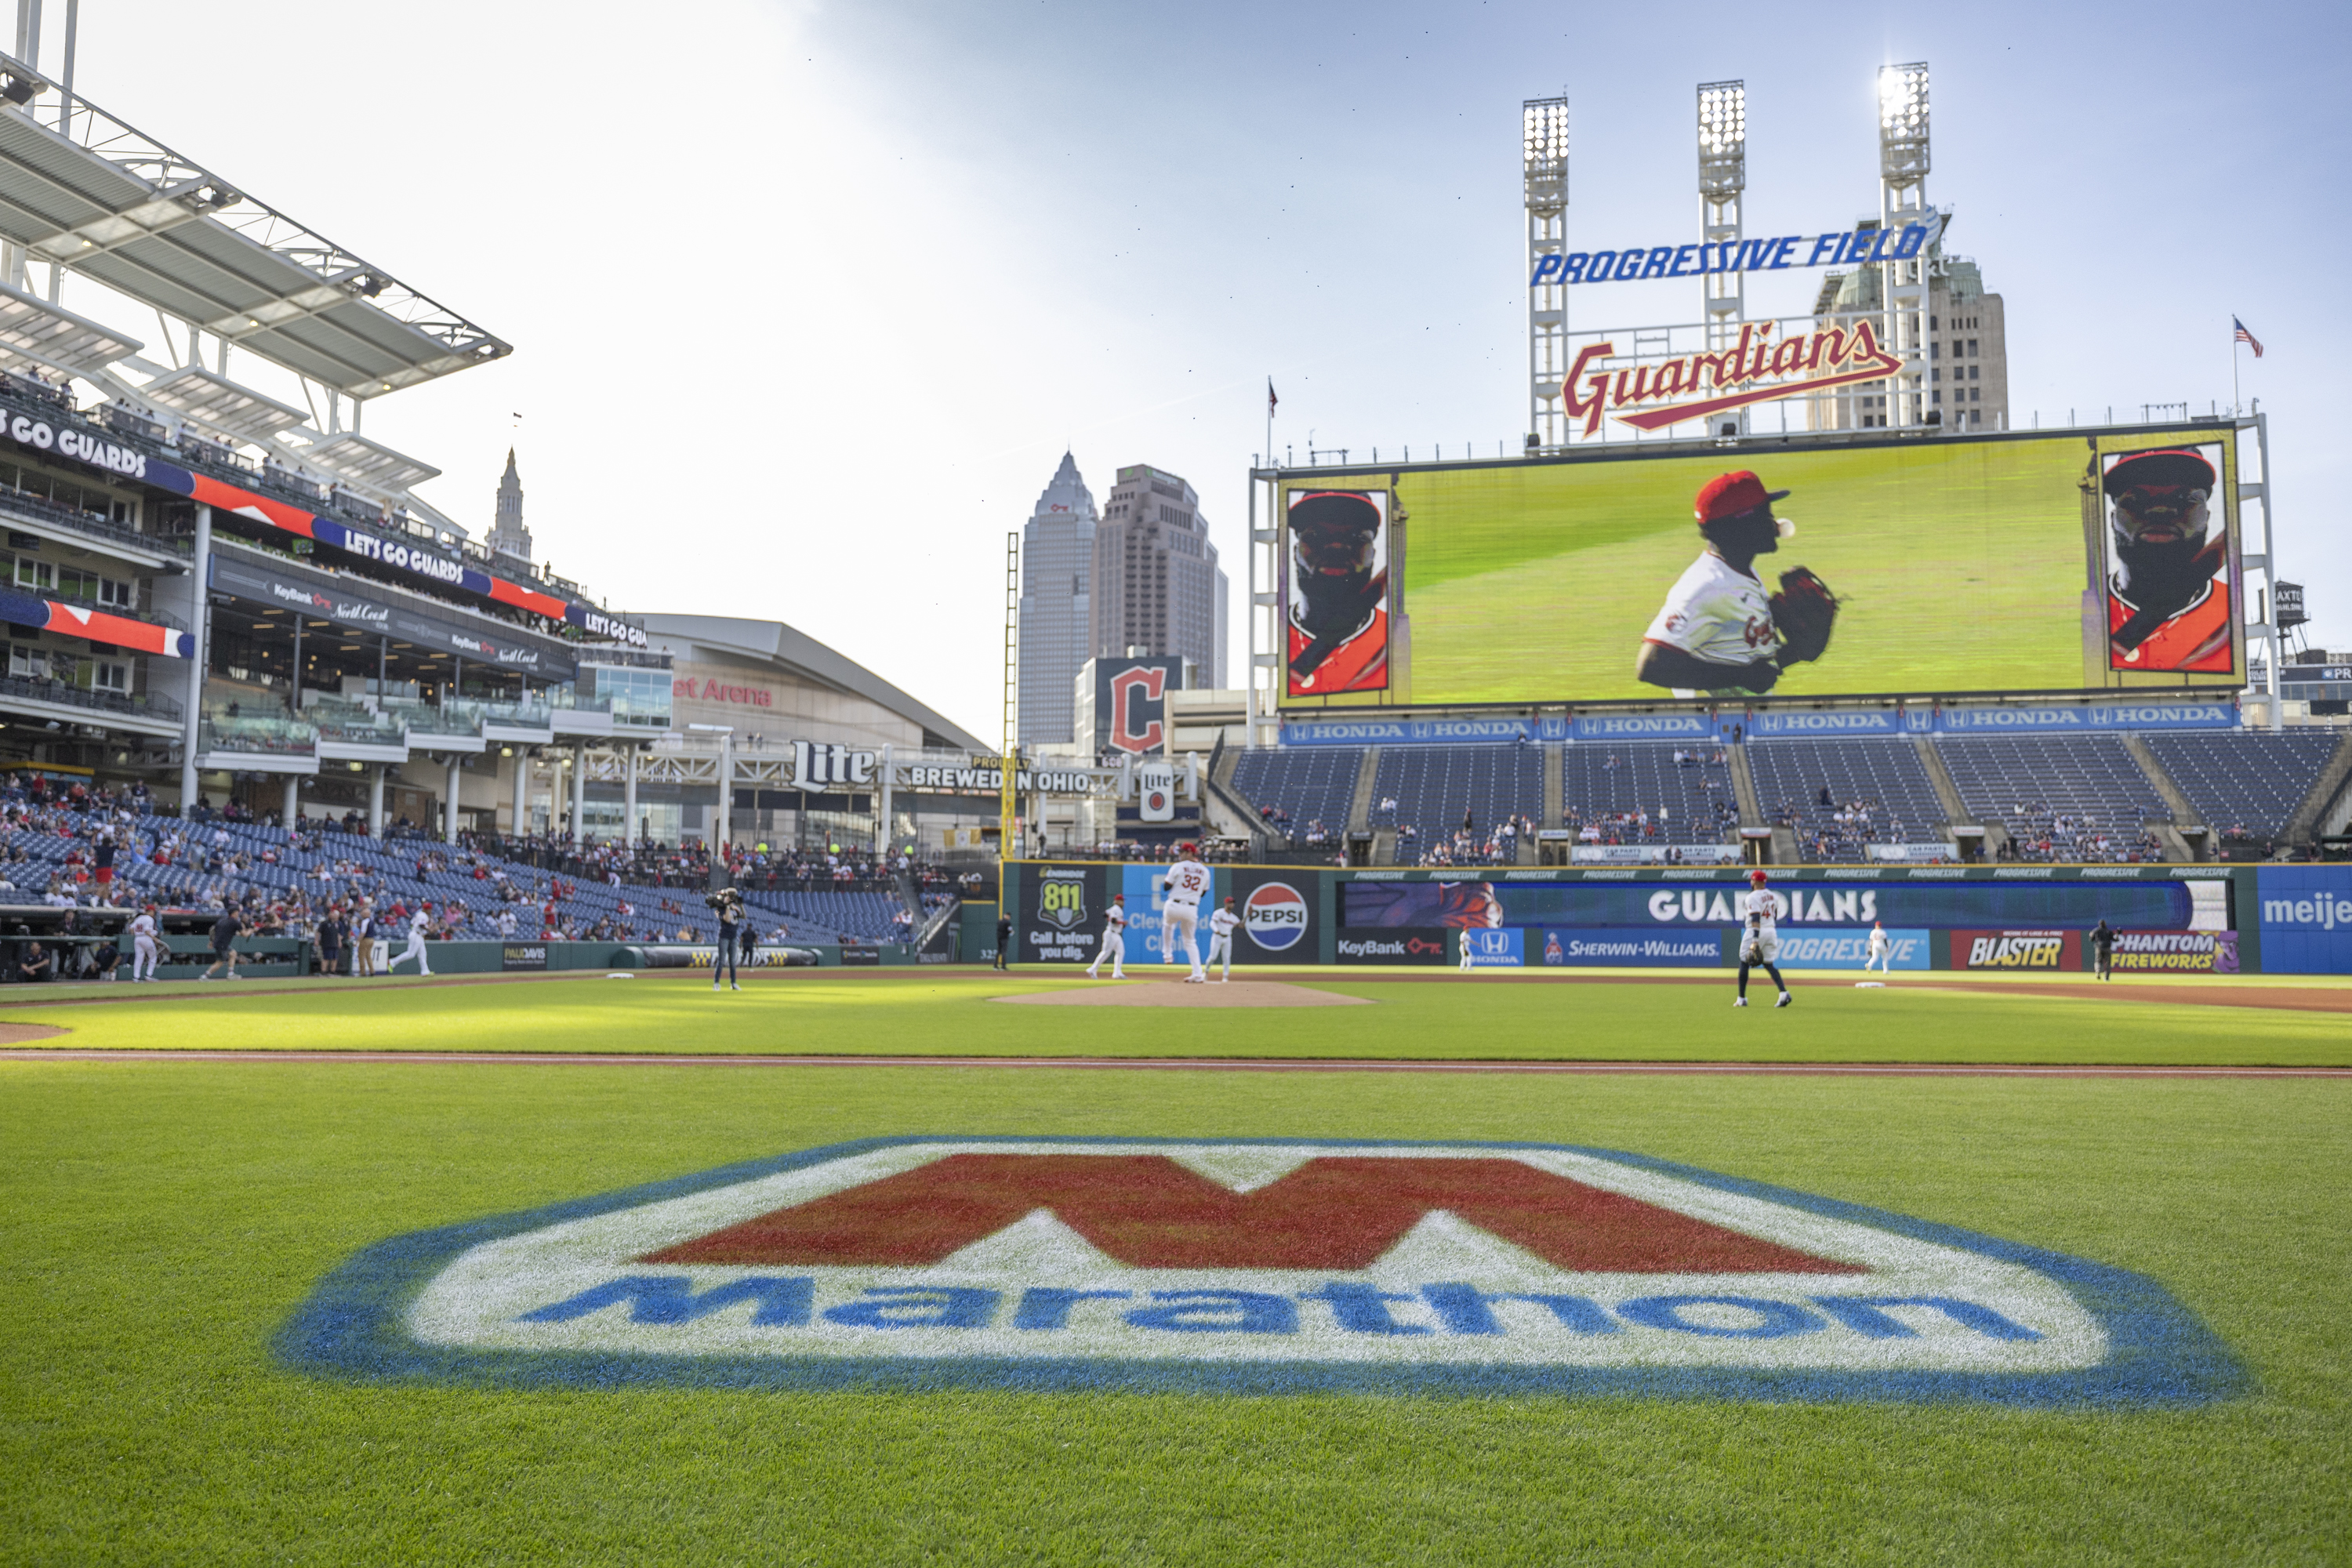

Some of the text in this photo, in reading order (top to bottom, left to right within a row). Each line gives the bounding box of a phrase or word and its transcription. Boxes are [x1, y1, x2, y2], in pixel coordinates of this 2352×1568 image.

[1530, 225, 1927, 287] PROGRESSIVE FIELD
[1561, 318, 1903, 440] Guardians
[11, 416, 53, 448] GO
[58, 430, 147, 478] GUARDS
[345, 529, 464, 585] LET'S GO GUARDS
[274, 583, 313, 605] KeyBank
[586, 612, 609, 635] LET'S
[610, 620, 627, 641] GO
[702, 678, 772, 707] Arena
[1784, 713, 1889, 729] HONDA
[1972, 710, 2081, 726] HONDA
[2118, 707, 2227, 722] HONDA
[1312, 724, 1405, 739] HONDA
[1433, 721, 1529, 736] HONDA
[1604, 718, 1703, 733] HONDA
[789, 739, 877, 794] Lite
[912, 766, 1003, 789] BREWED
[1036, 772, 1090, 793] OHIO
[1145, 773, 1171, 791] Lite
[1354, 871, 1407, 880] PROGRESSIVE
[1429, 871, 1482, 880] PROGRESSIVE
[1505, 870, 1559, 880] PROGRESSIVE
[1583, 870, 1637, 879] PROGRESSIVE
[1661, 869, 1716, 879] PROGRESSIVE
[1742, 869, 1799, 878] PRRESSIVE
[1824, 869, 1882, 878] PROGRESSIVE
[1908, 868, 1966, 877] PROGRESSIVE
[1994, 868, 2053, 877] PROGRESSIVE
[2080, 867, 2141, 877] PROGRESSIVE
[2169, 867, 2232, 877] PROGRESSIVE
[1181, 874, 1201, 891] 32
[1044, 883, 1080, 911] 811
[1249, 909, 1303, 923] PEPSI
[1029, 931, 1094, 946] Call before
[2111, 934, 2215, 952] PHANTOM
[1040, 946, 1085, 961] you dig.
[1338, 940, 1406, 956] KeyBank
[1968, 937, 2063, 967] BLASTER
[1472, 955, 1519, 964] HONDA
[2111, 953, 2214, 970] FIREWORKS
[514, 1273, 2043, 1341] Marathon
